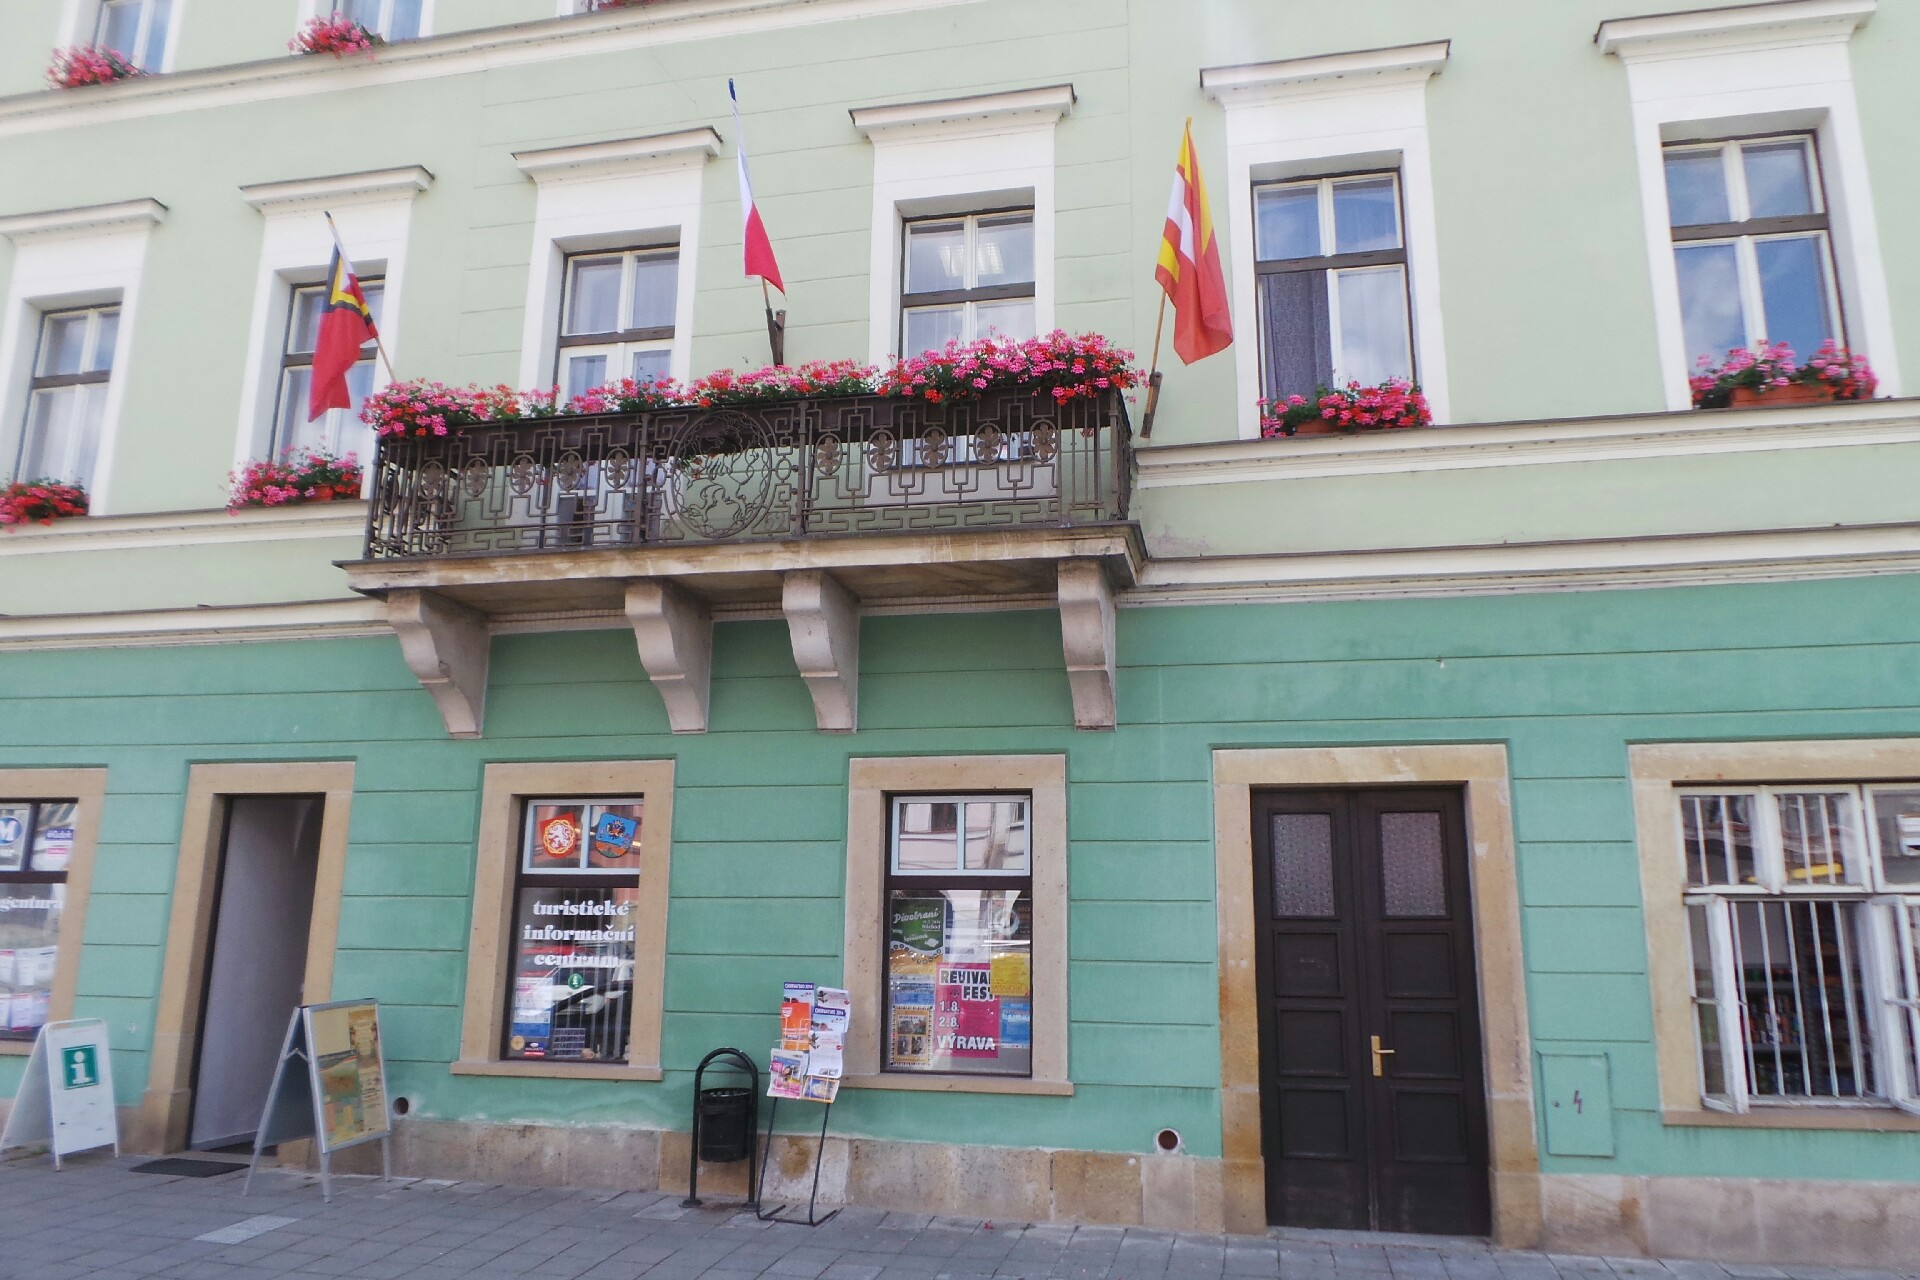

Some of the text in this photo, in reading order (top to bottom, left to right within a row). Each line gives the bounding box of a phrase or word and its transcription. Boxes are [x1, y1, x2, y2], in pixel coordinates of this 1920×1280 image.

[533, 900, 629, 916] turistické
[523, 924, 635, 941] informační
[534, 952, 619, 967] centrum
[937, 1033, 995, 1050] VÝRAVA
